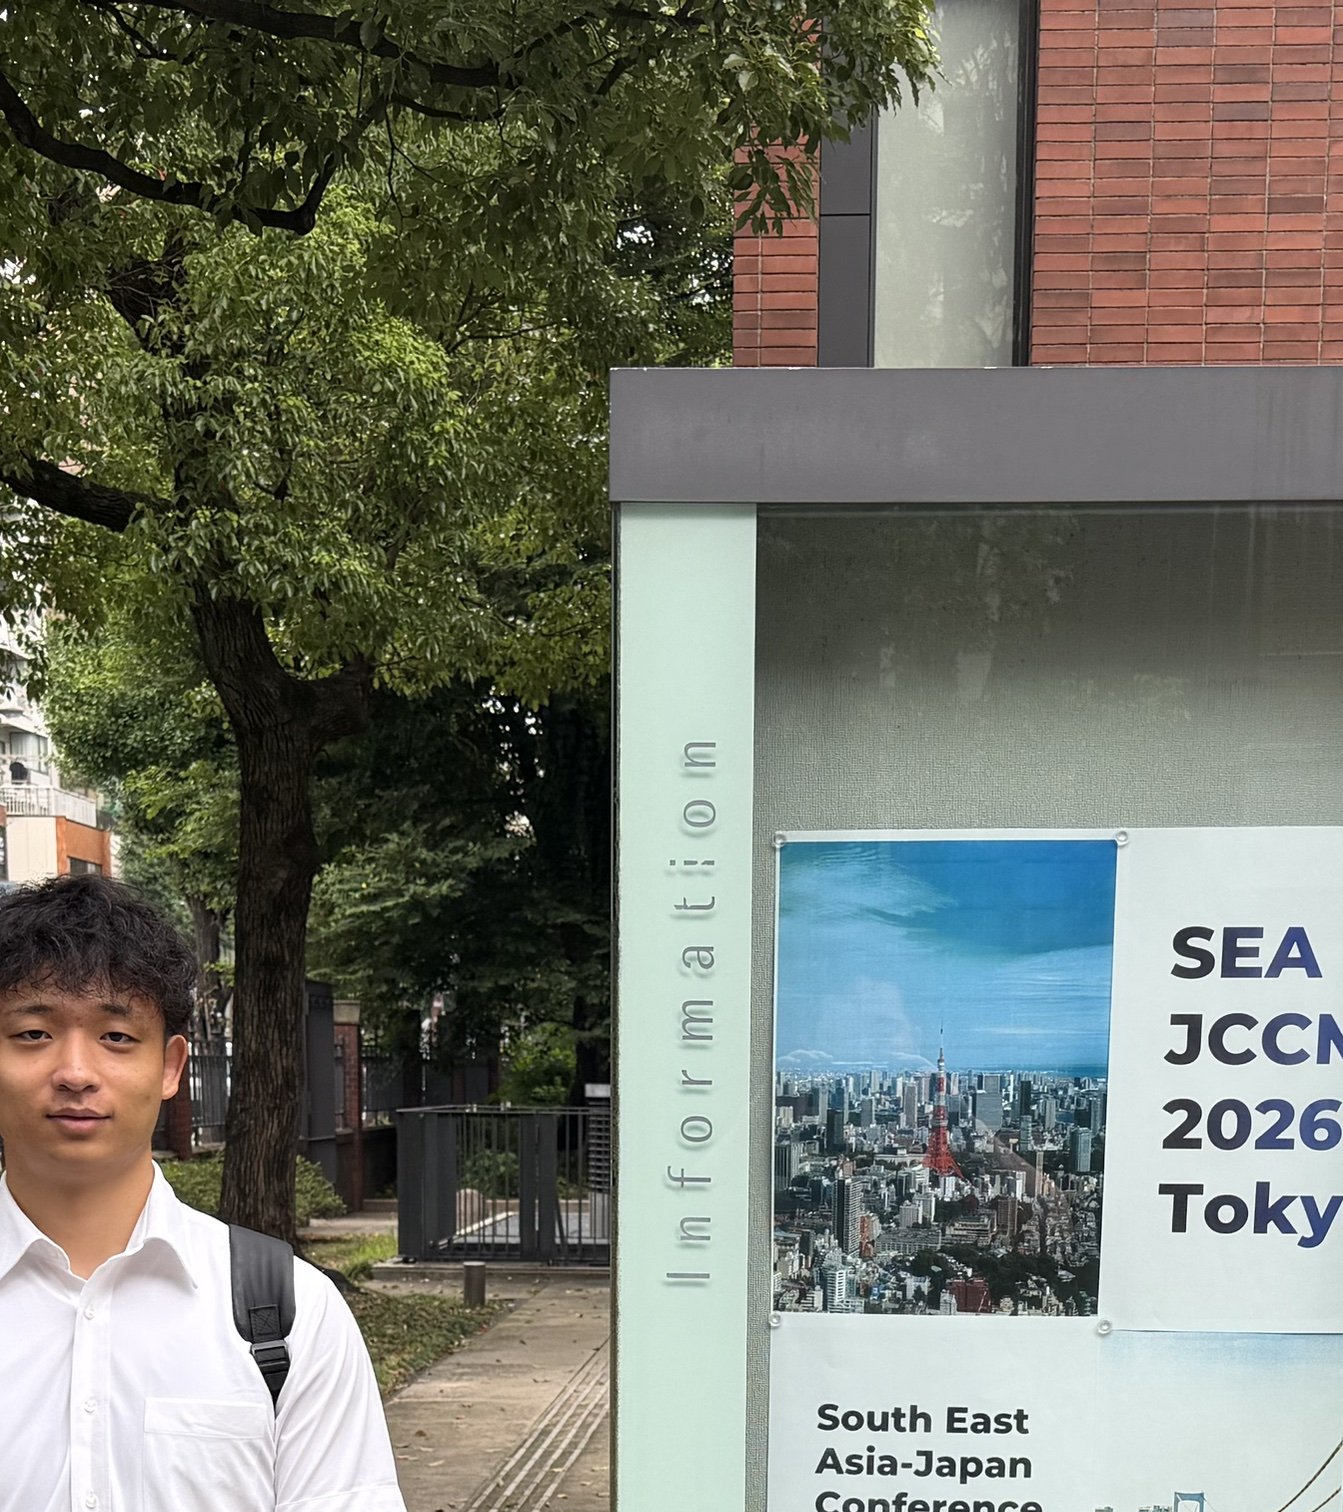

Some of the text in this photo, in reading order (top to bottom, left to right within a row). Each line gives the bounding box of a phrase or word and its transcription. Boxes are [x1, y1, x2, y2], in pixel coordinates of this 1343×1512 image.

[1170, 925, 1322, 979] SEA
[665, 740, 717, 1281] Information
[1162, 1098, 1342, 1150] 2026
[816, 1403, 1029, 1434] South East
[814, 1444, 1031, 1484] Asia-Japan
